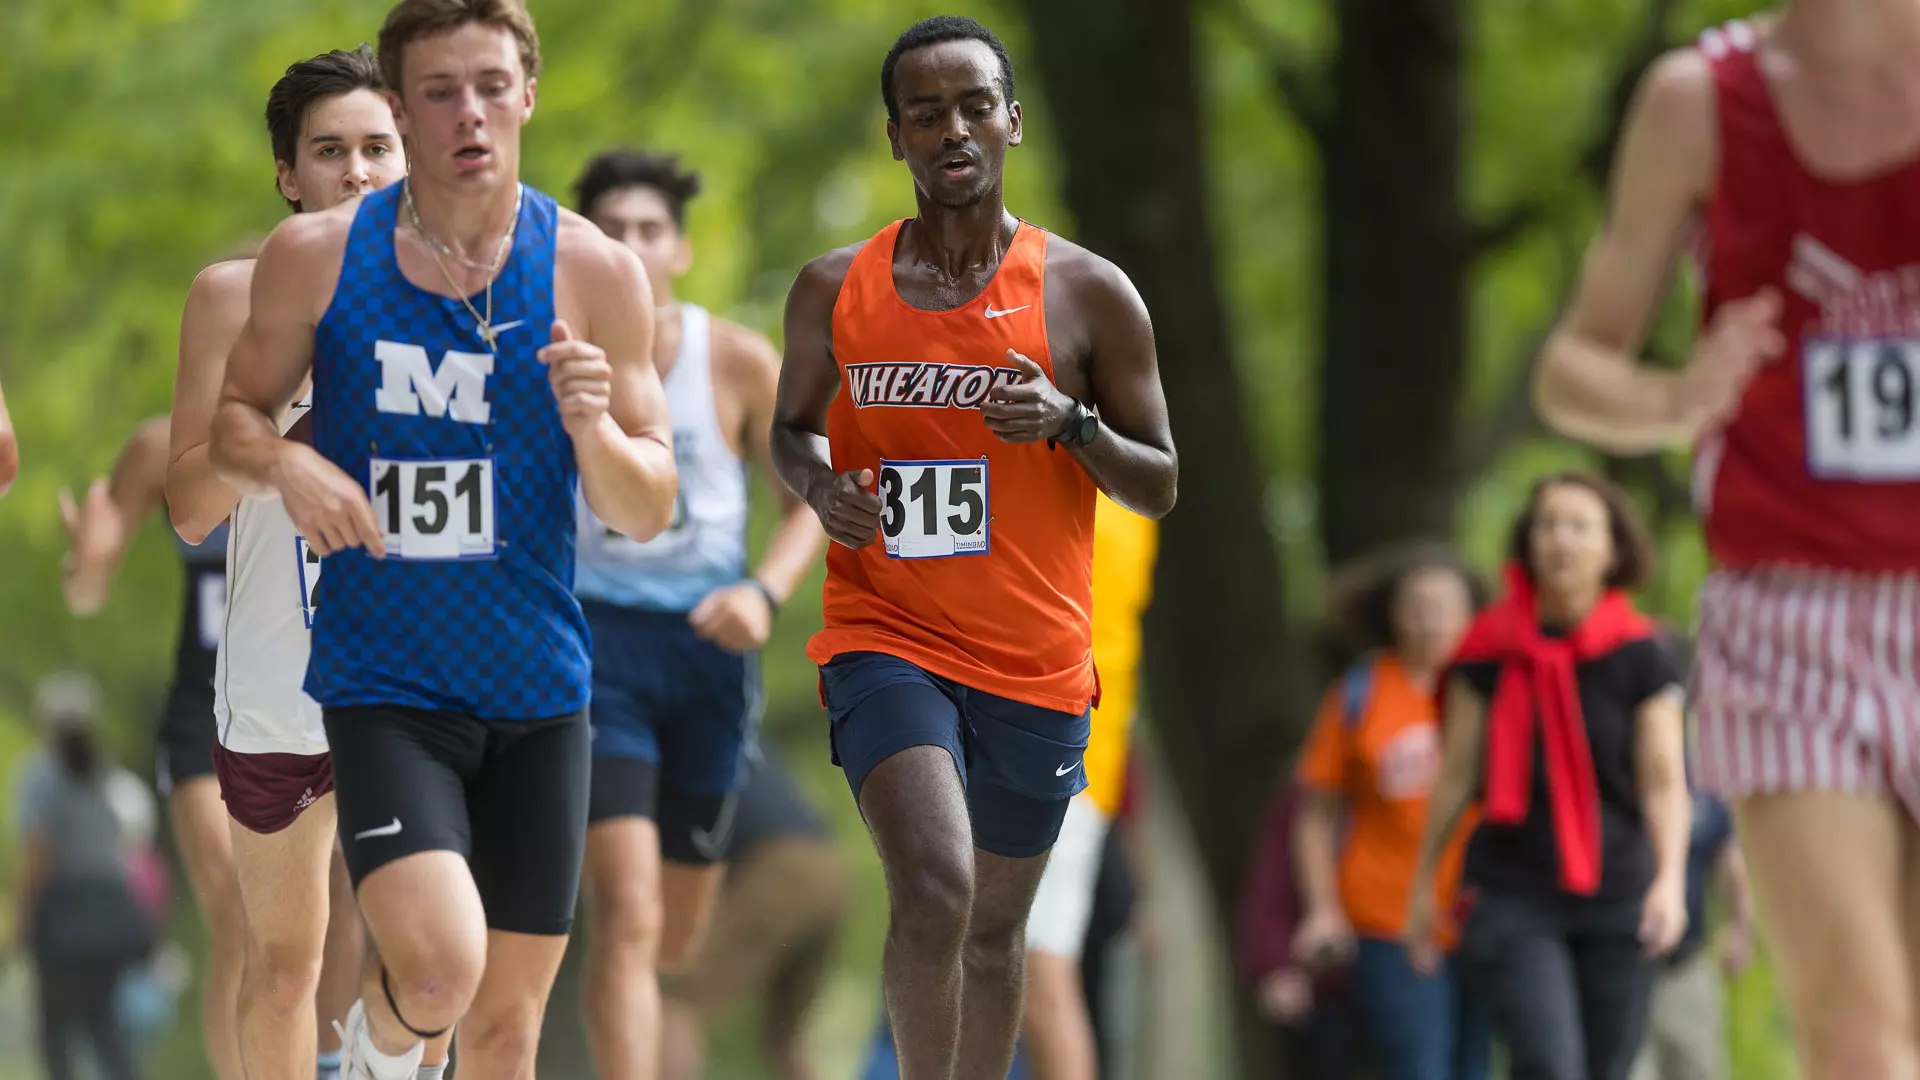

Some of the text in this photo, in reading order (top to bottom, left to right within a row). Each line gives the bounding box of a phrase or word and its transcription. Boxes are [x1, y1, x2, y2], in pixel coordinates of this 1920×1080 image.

[374, 340, 494, 424] M
[376, 464, 483, 534] 151
[880, 467, 983, 537] 315
